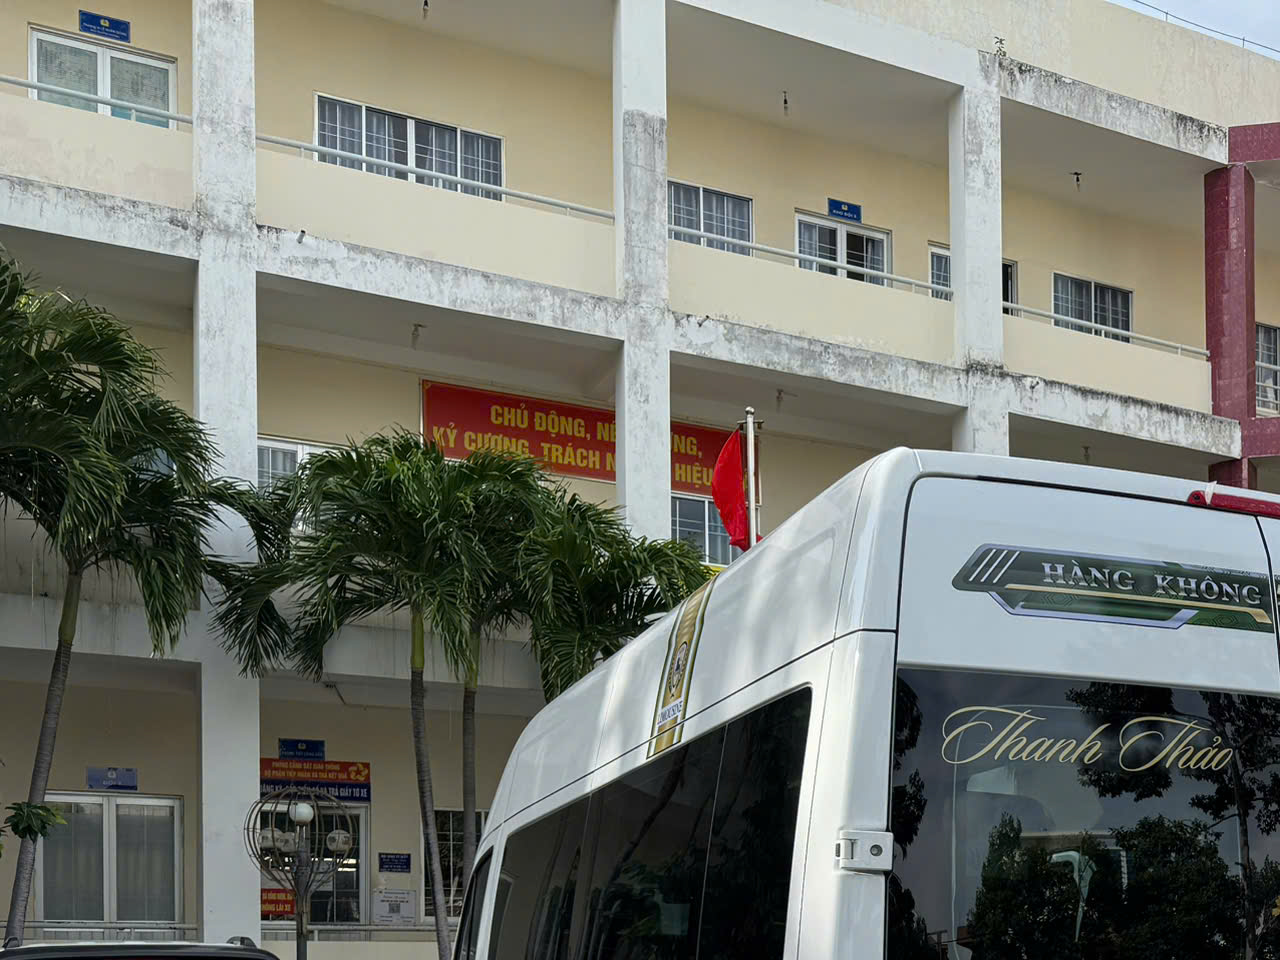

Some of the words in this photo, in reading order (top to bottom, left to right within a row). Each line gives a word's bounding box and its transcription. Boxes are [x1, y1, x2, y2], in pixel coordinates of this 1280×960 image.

[490, 403, 529, 429] CHỦ
[535, 410, 591, 441] ĐỘNG,
[597, 421, 616, 442] NÊ
[433, 422, 458, 449] KỶ
[541, 443, 600, 470] TRÁCH
[675, 462, 713, 488] HIỆU
[1041, 560, 1135, 590] HÀNG
[1153, 574, 1262, 606] KHÔNG
[941, 704, 1108, 766] Thanh
[1118, 715, 1234, 773] Thảo
